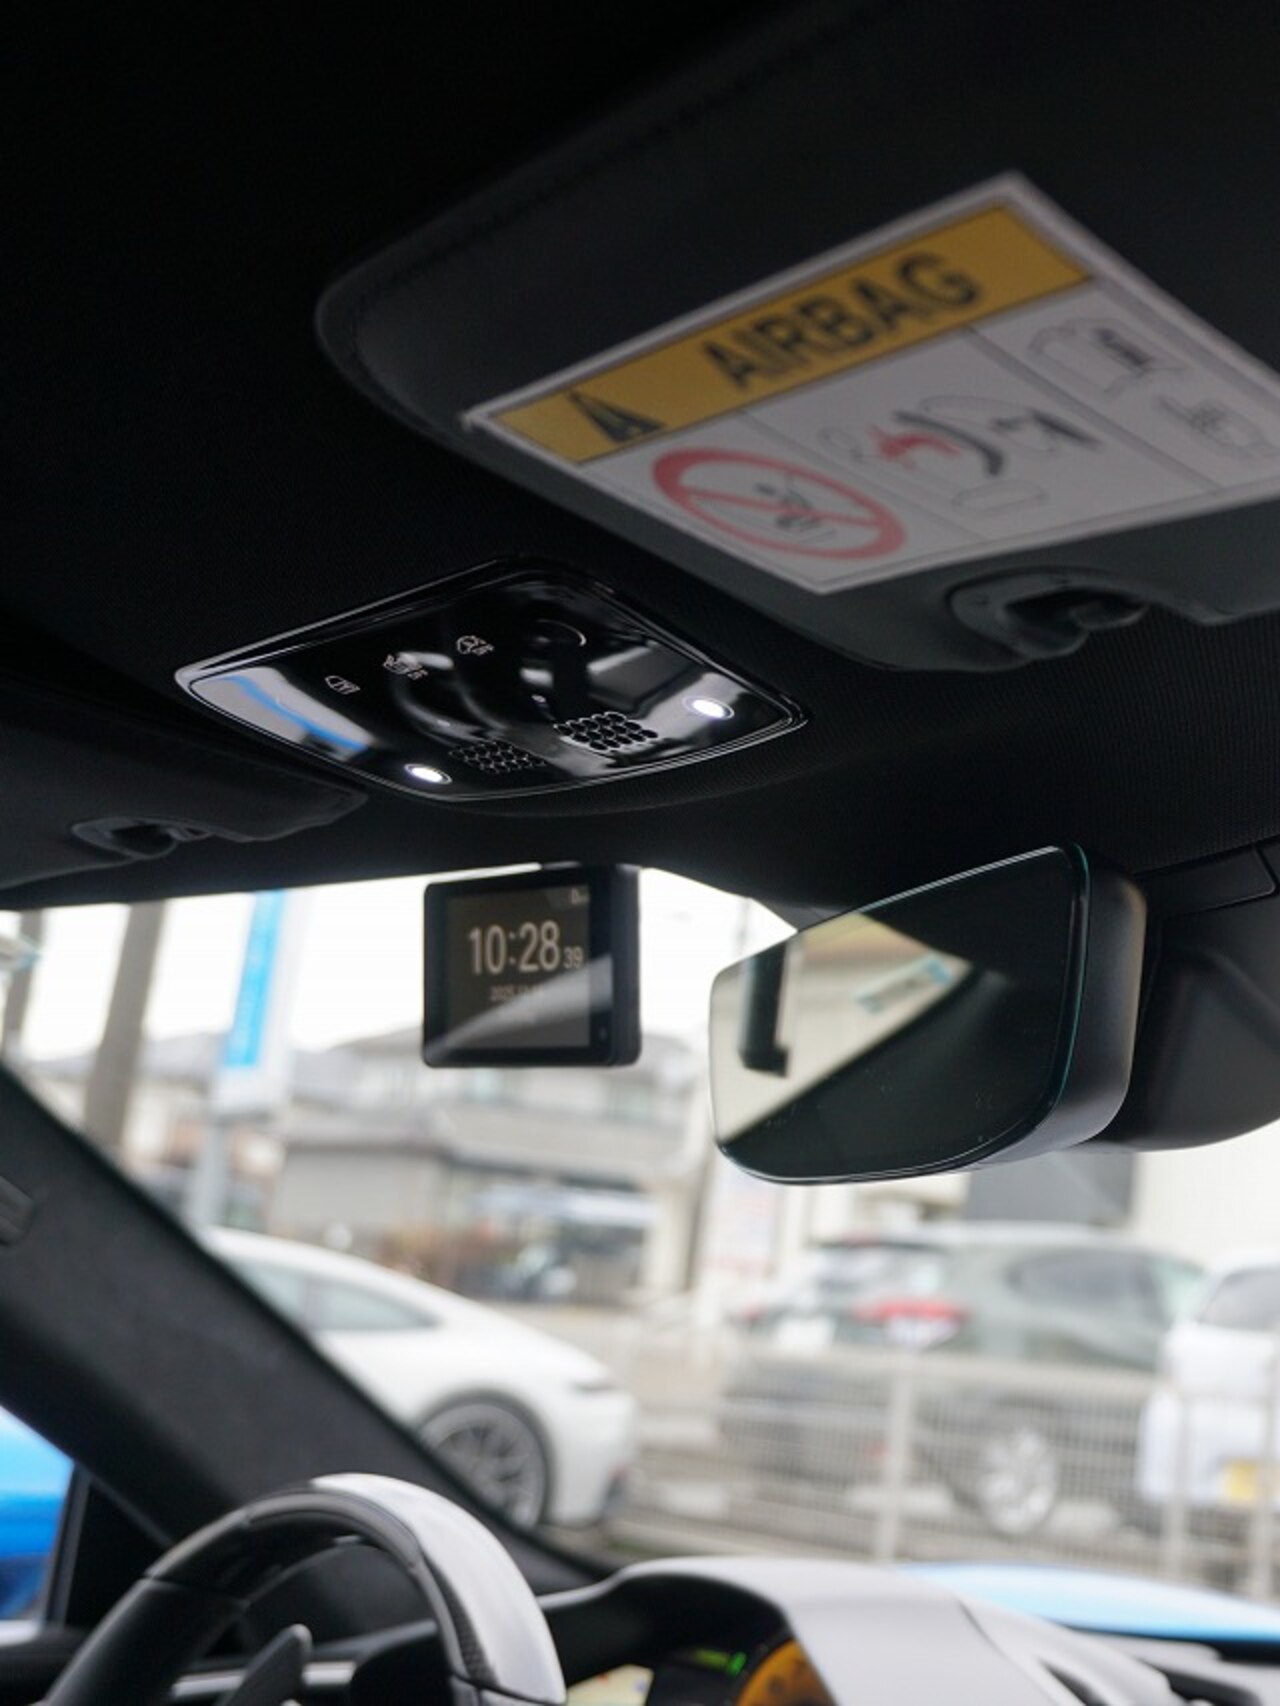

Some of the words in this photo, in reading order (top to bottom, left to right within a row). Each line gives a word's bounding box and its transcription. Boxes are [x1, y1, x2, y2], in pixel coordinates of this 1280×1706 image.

[701, 252, 979, 388] AIRBAG
[468, 919, 560, 975] 10:28
[563, 945, 584, 970] 39
